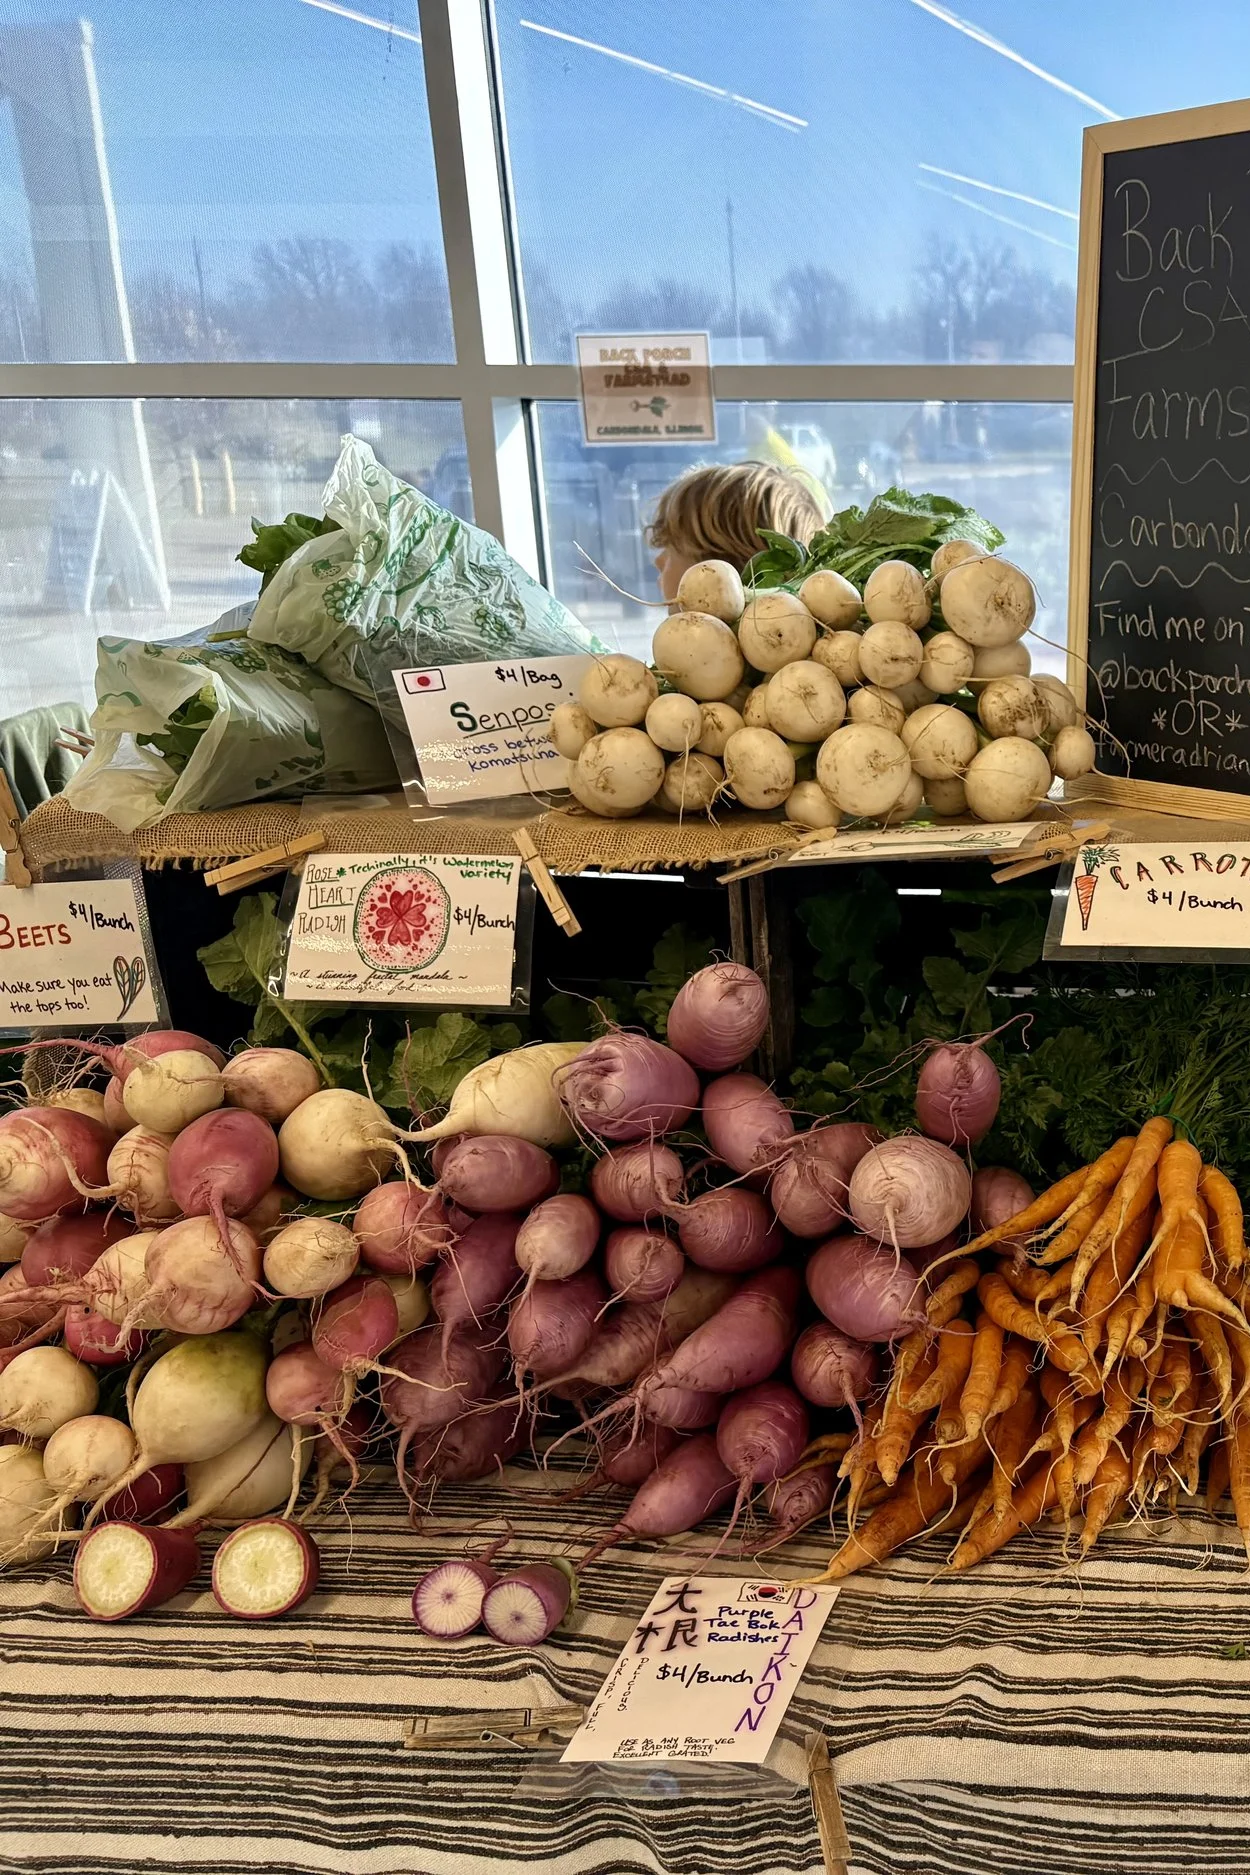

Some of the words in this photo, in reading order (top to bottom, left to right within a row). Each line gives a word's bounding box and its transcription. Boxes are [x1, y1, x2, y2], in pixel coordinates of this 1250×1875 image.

[1114, 179, 1234, 283] Back
[1094, 600, 1159, 641] Find
[1166, 617, 1207, 643] me
[1214, 615, 1245, 649] on
[495, 666, 563, 689] $4/Bag
[450, 701, 557, 733] Senpos
[305, 863, 338, 883] ROSE
[460, 869, 512, 885] variety
[308, 884, 357, 908] HEART
[1146, 888, 1244, 912] $4/Bunch
[68, 900, 135, 932] $4/Bunch
[298, 912, 346, 935] RADISH
[452, 903, 516, 935] $4/Bunch
[0, 913, 73, 950] BEETS
[0, 980, 35, 994] Make
[35, 978, 66, 993] sure
[67, 977, 91, 996] you
[92, 972, 113, 988] eat
[10, 1000, 33, 1013] the
[35, 998, 62, 1016] tops
[65, 994, 91, 1012] too!
[633, 1582, 703, 1655] 大根
[702, 1617, 741, 1629] Tae
[747, 1619, 781, 1631] Bok
[717, 1605, 775, 1621] Purple
[707, 1631, 780, 1644] Radishes
[734, 1586, 818, 1733] DAIKON
[655, 1662, 754, 1689] $4/Bunch
[620, 1738, 639, 1746] USE
[660, 1736, 679, 1745] ANY
[684, 1736, 710, 1744] ROOT
[714, 1737, 736, 1745] VEG
[641, 1743, 679, 1752] RADISH
[612, 1750, 663, 1759] EXCELLENT
